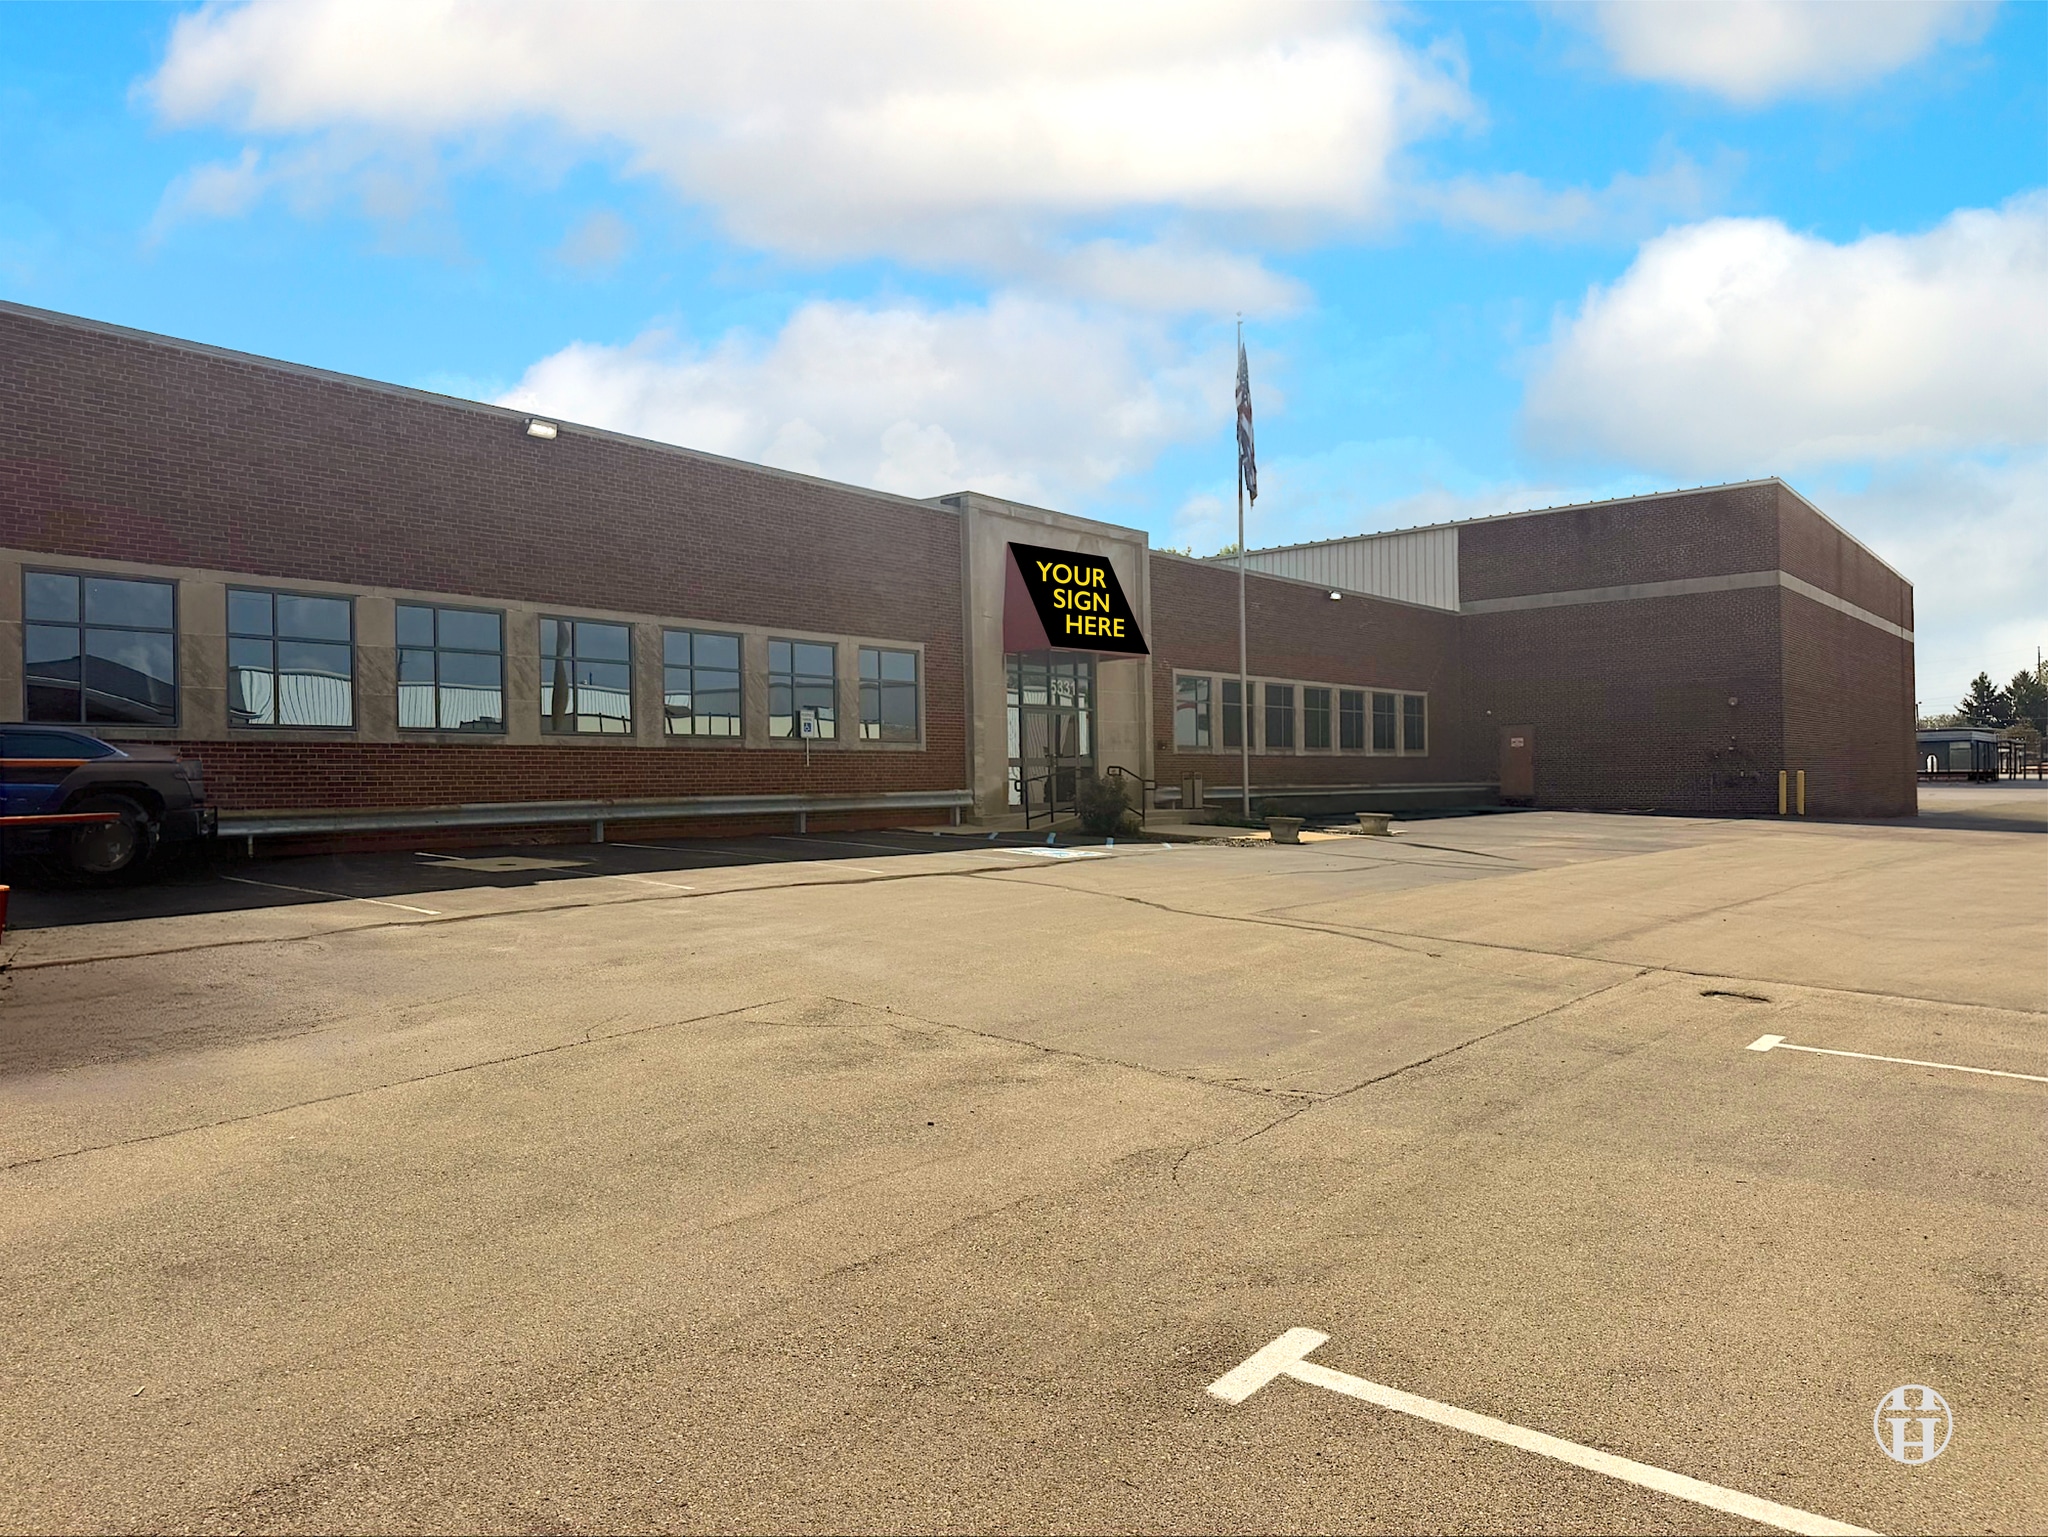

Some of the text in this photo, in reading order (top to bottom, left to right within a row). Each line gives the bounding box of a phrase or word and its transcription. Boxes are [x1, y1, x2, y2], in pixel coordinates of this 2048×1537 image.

[1036, 560, 1107, 588] YOUR
[1053, 588, 1110, 613] SIGN
[1066, 614, 1125, 638] HERE
[1051, 680, 1076, 695] 5331
